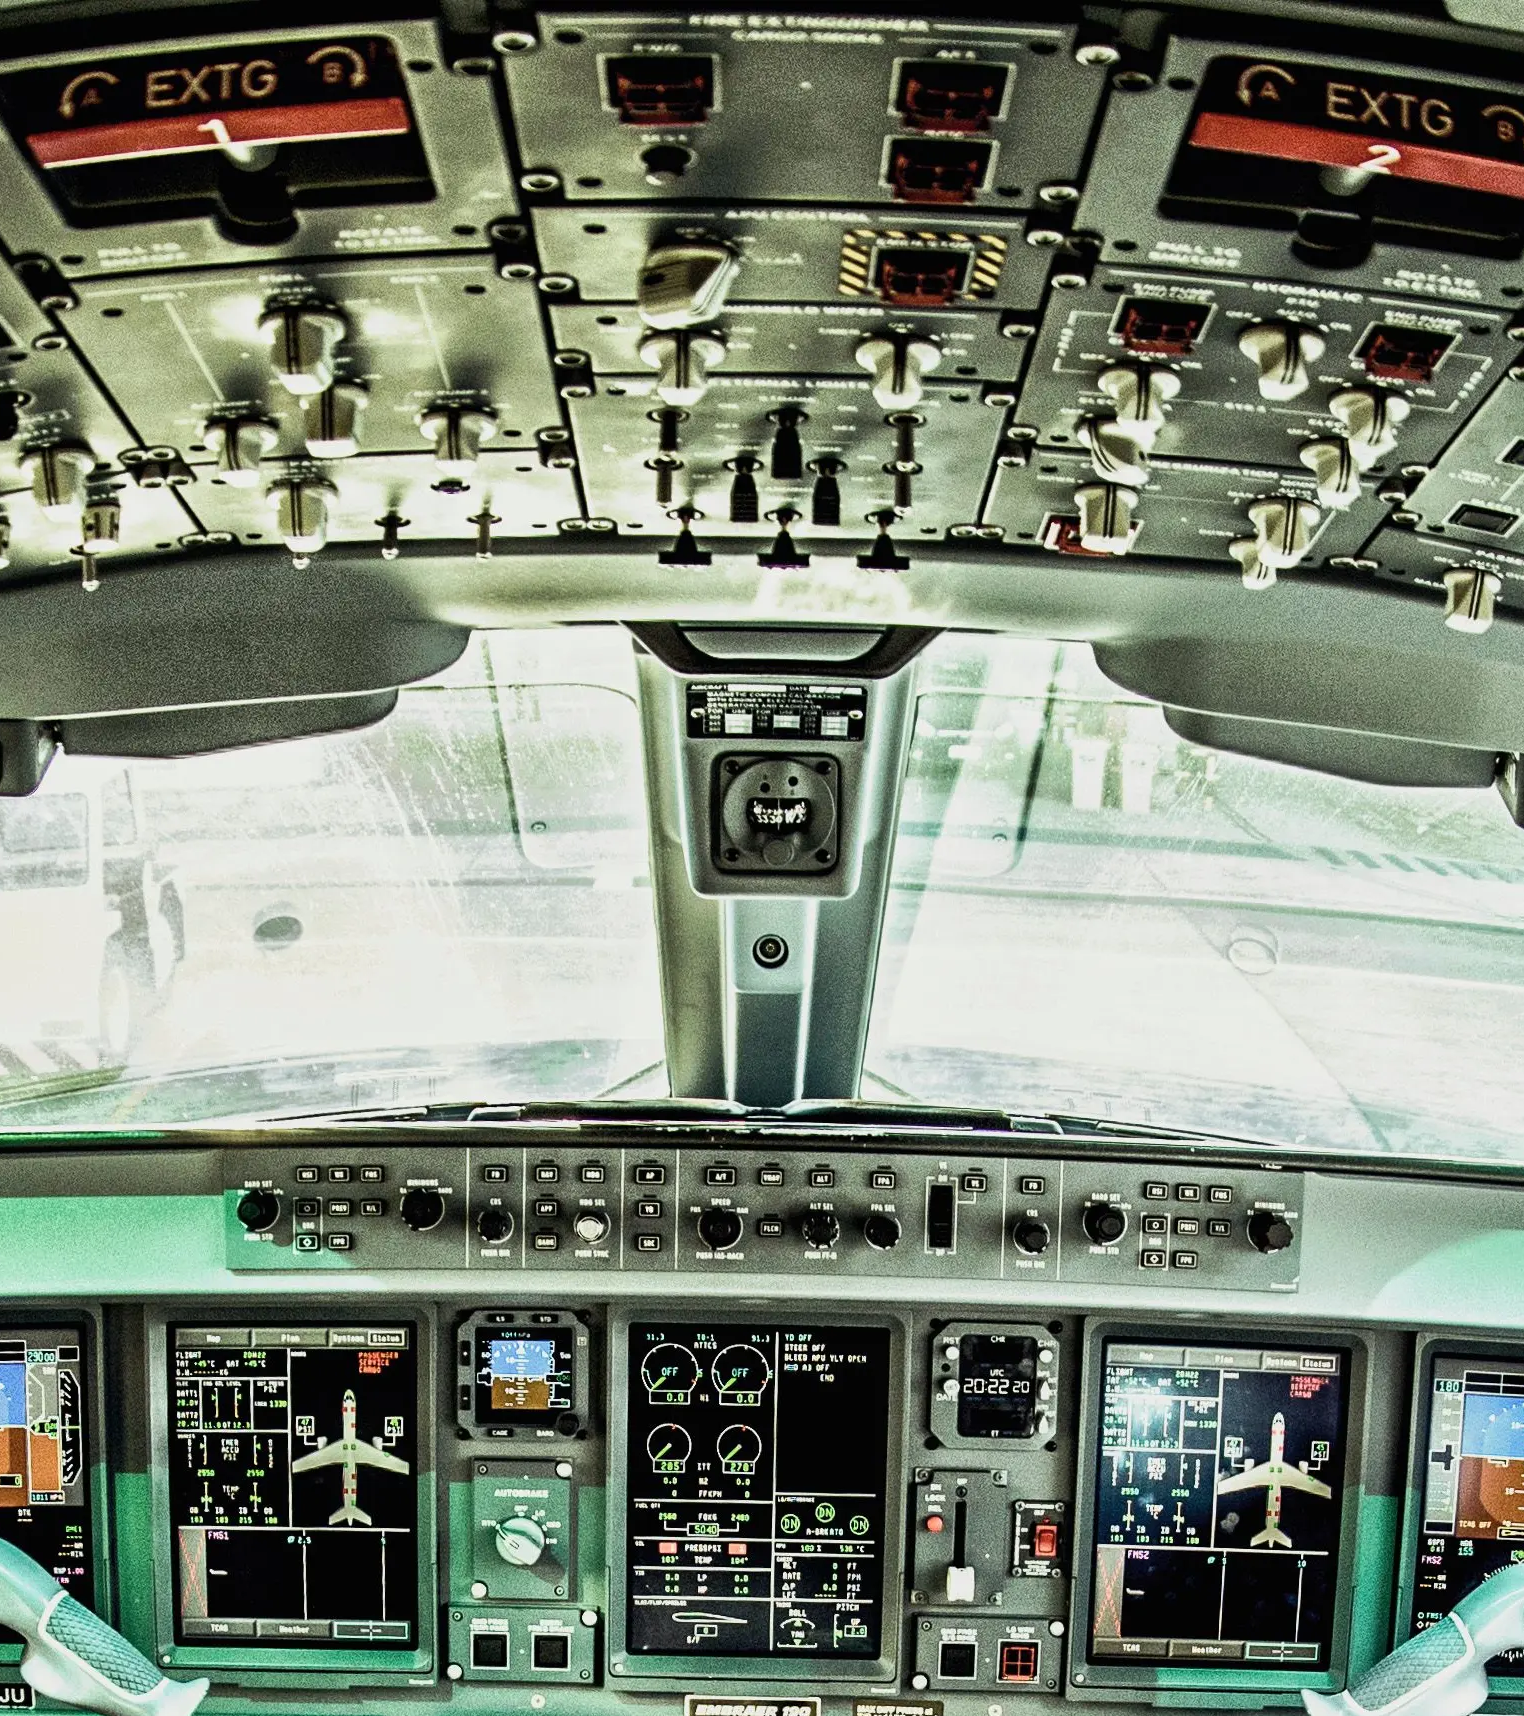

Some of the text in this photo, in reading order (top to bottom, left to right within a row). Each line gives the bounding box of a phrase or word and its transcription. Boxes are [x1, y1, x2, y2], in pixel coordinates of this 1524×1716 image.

[145, 60, 277, 109] EXTG
[1325, 82, 1453, 137] EXTG
[1359, 144, 1402, 175] 2
[661, 1367, 679, 1377] OFF
[731, 1368, 749, 1378] OFF
[990, 1369, 1004, 1377] UTC
[963, 1378, 1030, 1394] 20:22 20
[1439, 1382, 1460, 1392] 180
[666, 1393, 684, 1403] 0.0
[736, 1394, 755, 1404] 0.0
[494, 1489, 549, 1498] AUTOBRAKE
[694, 1525, 717, 1534] 5040
[208, 1531, 229, 1540] FMS1
[1128, 1550, 1149, 1559] FMS2
[1422, 1556, 1442, 1565] FMS2
